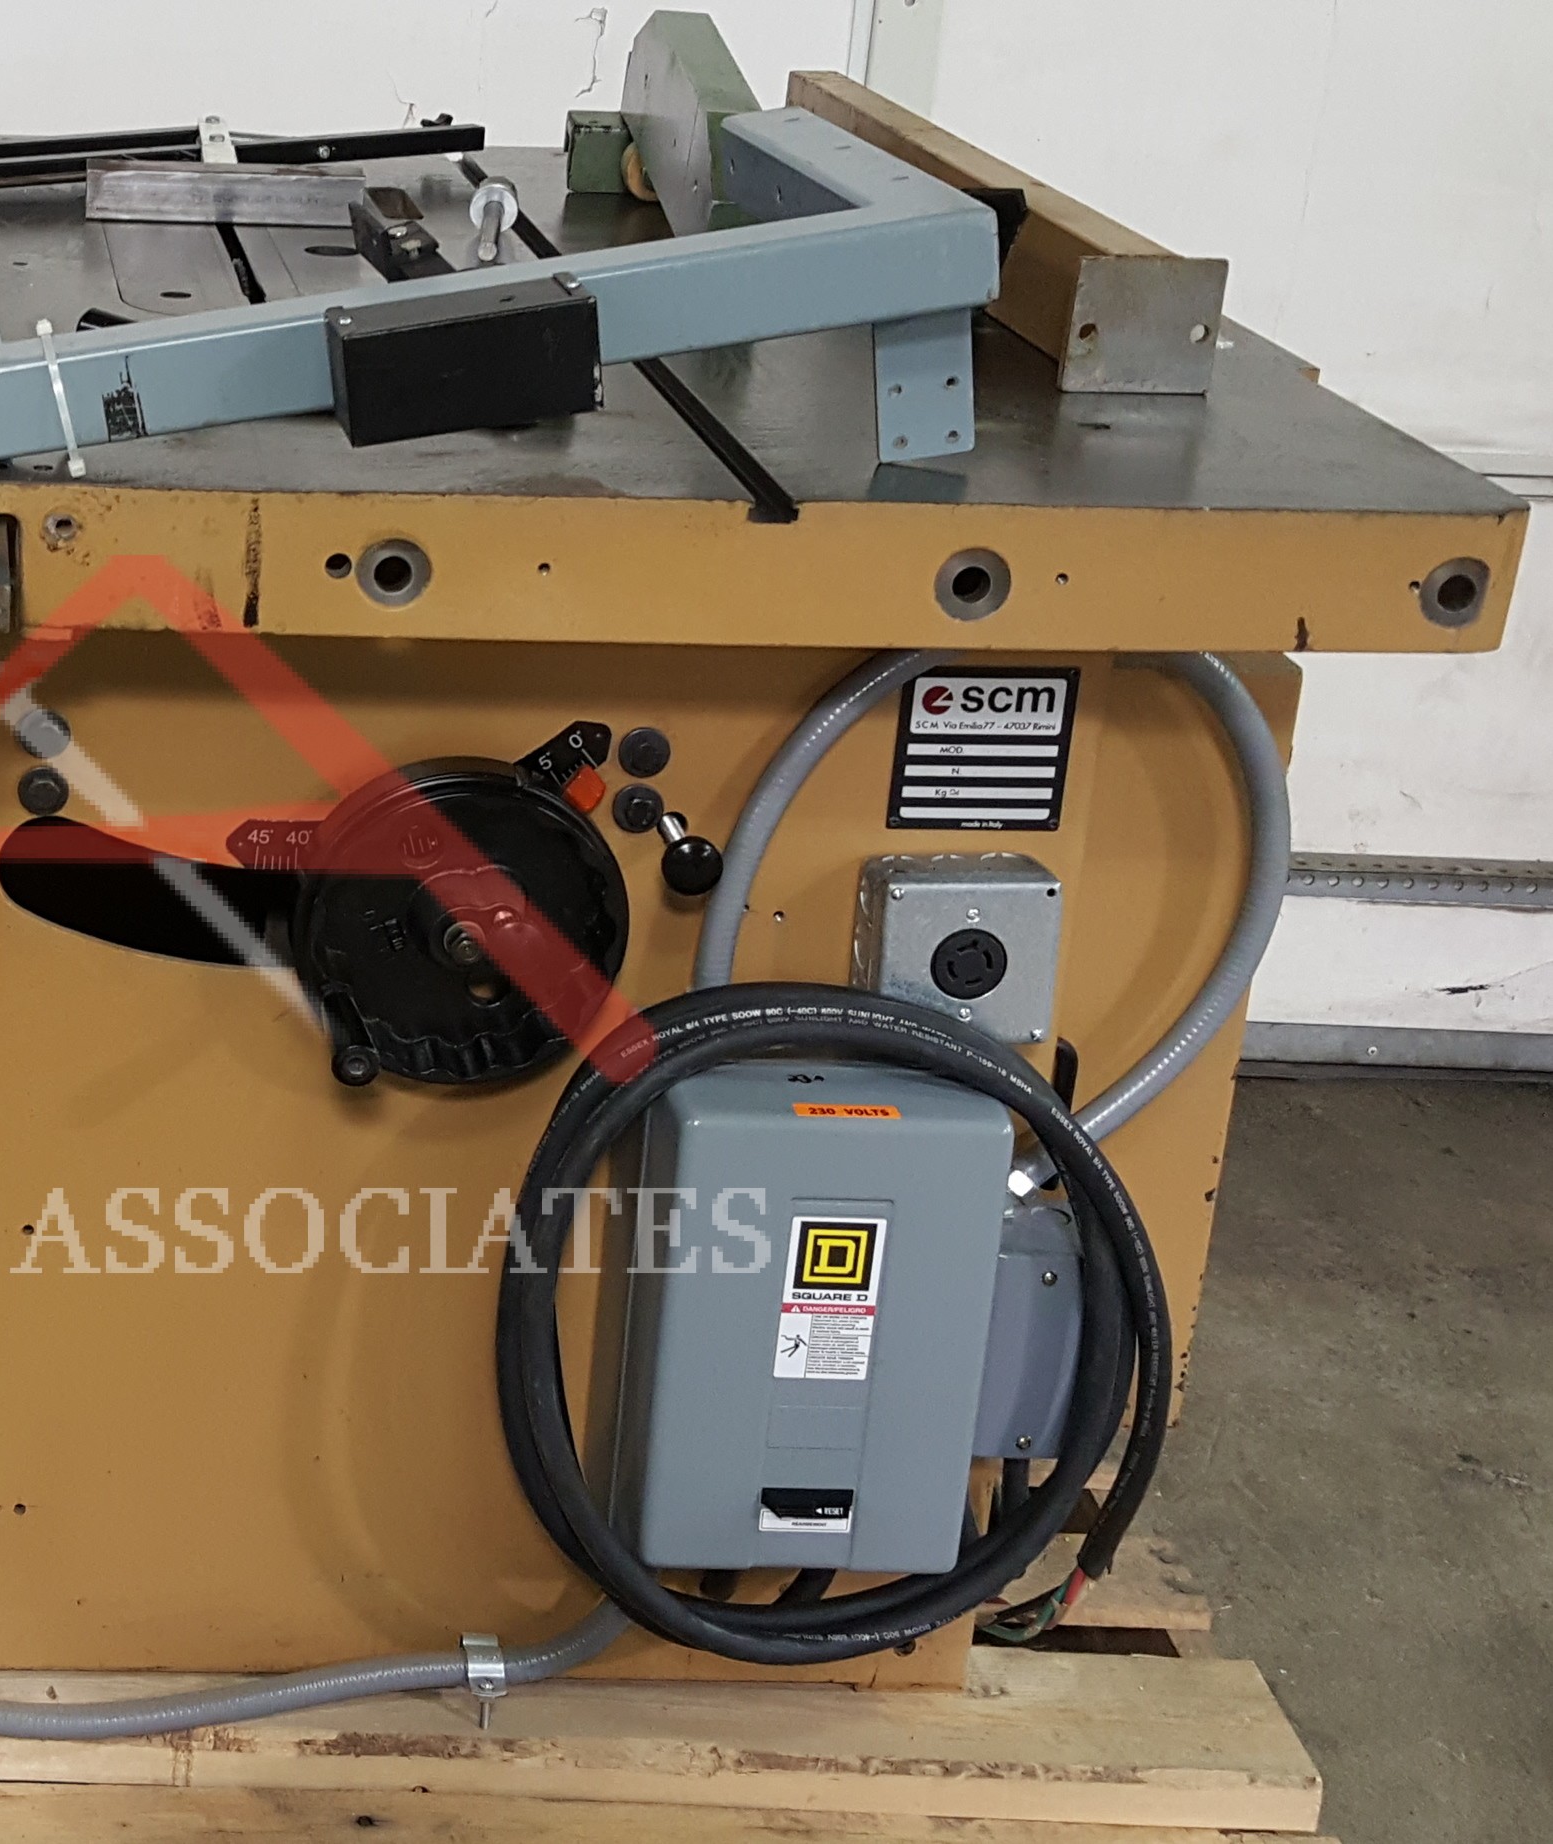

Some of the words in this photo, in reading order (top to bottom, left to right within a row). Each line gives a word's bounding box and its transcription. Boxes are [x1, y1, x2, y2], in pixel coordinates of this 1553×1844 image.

[960, 685, 1056, 713] scm
[944, 721, 957, 730] Via
[652, 1025, 683, 1041] ROYAL
[703, 1014, 728, 1026] TYPE
[732, 1010, 761, 1021] SOOW
[873, 1021, 908, 1034] WATER
[808, 1107, 836, 1115] 230
[844, 1108, 890, 1117] VOLTS
[1073, 1131, 1094, 1157] ROYAL
[1101, 1169, 1116, 1190] TYPE
[792, 1292, 852, 1301] SQUARE
[856, 1294, 868, 1302] D
[824, 1507, 843, 1516] RESET
